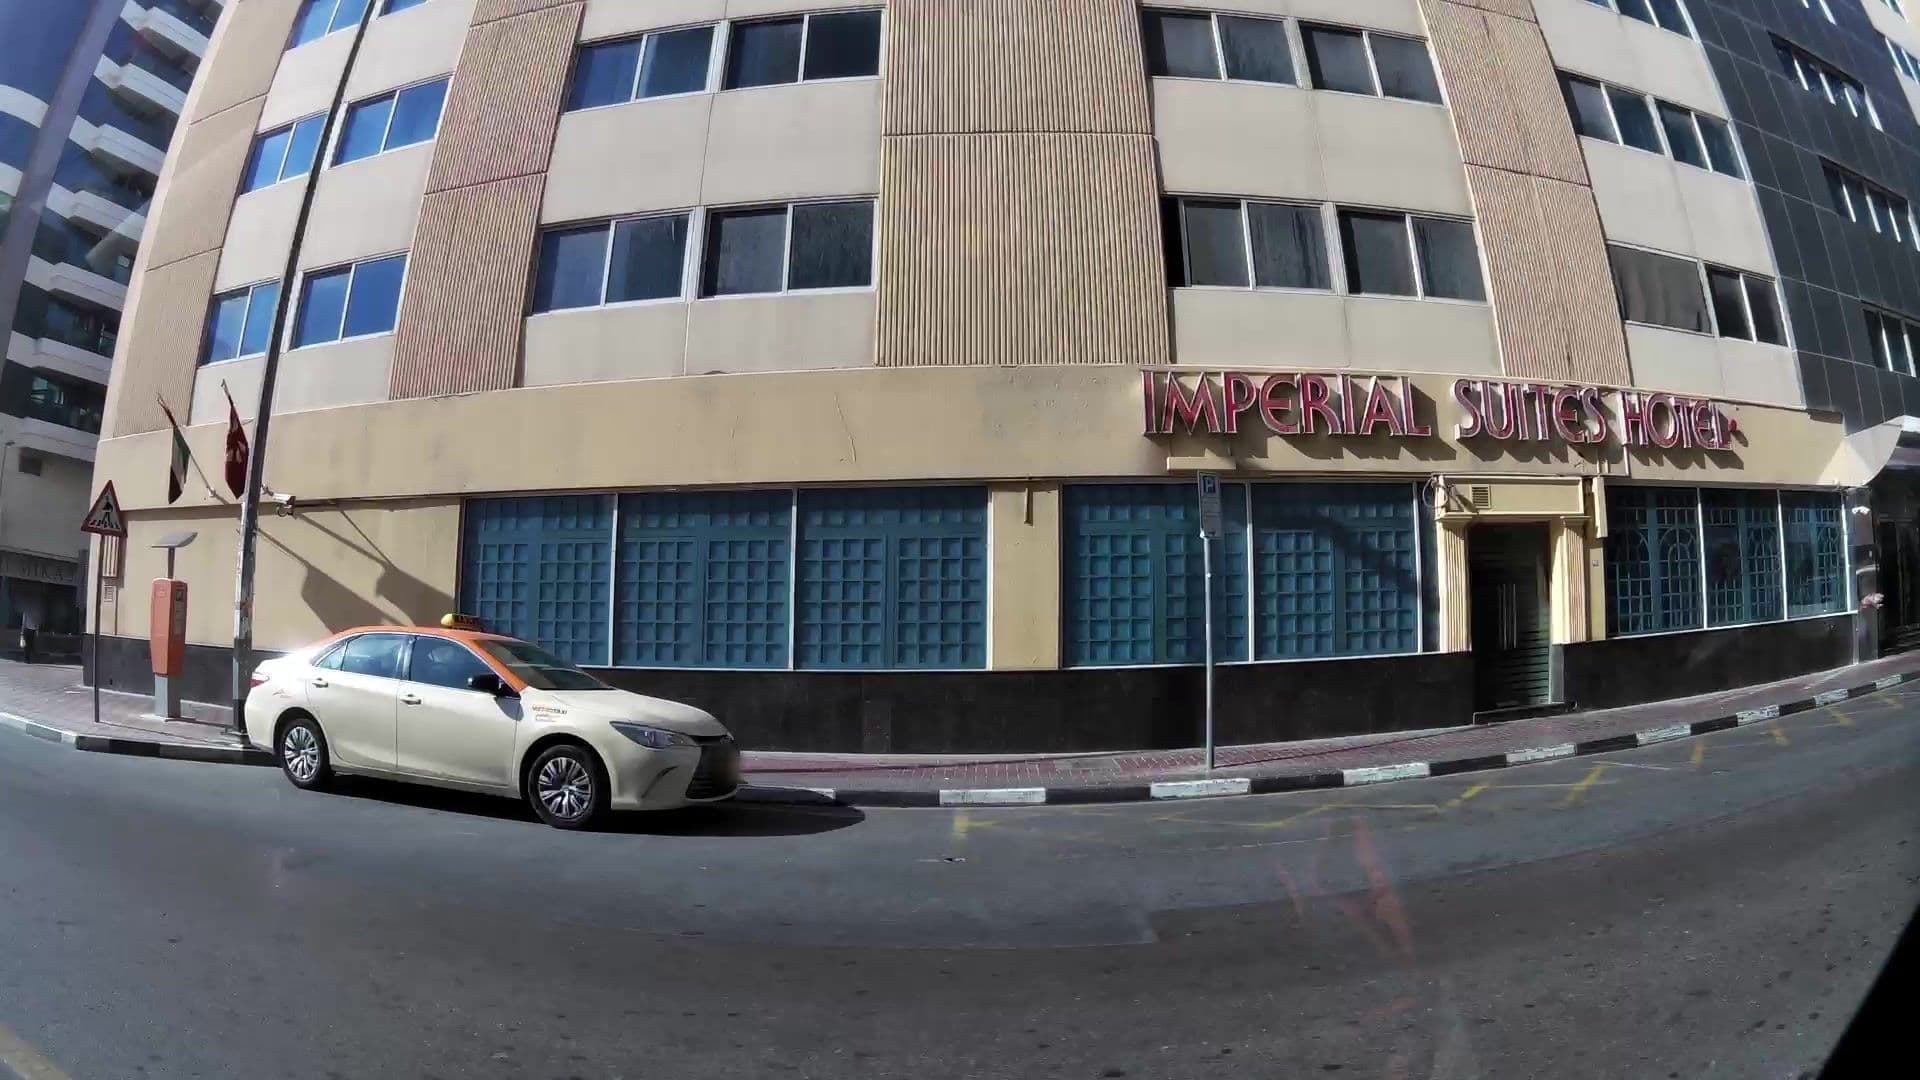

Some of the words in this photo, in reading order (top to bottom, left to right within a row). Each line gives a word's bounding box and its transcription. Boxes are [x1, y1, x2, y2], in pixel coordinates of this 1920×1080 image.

[1141, 370, 1432, 436] IMPERIAL
[1450, 379, 1607, 443] SUITES
[1615, 389, 1733, 450] HOTEL
